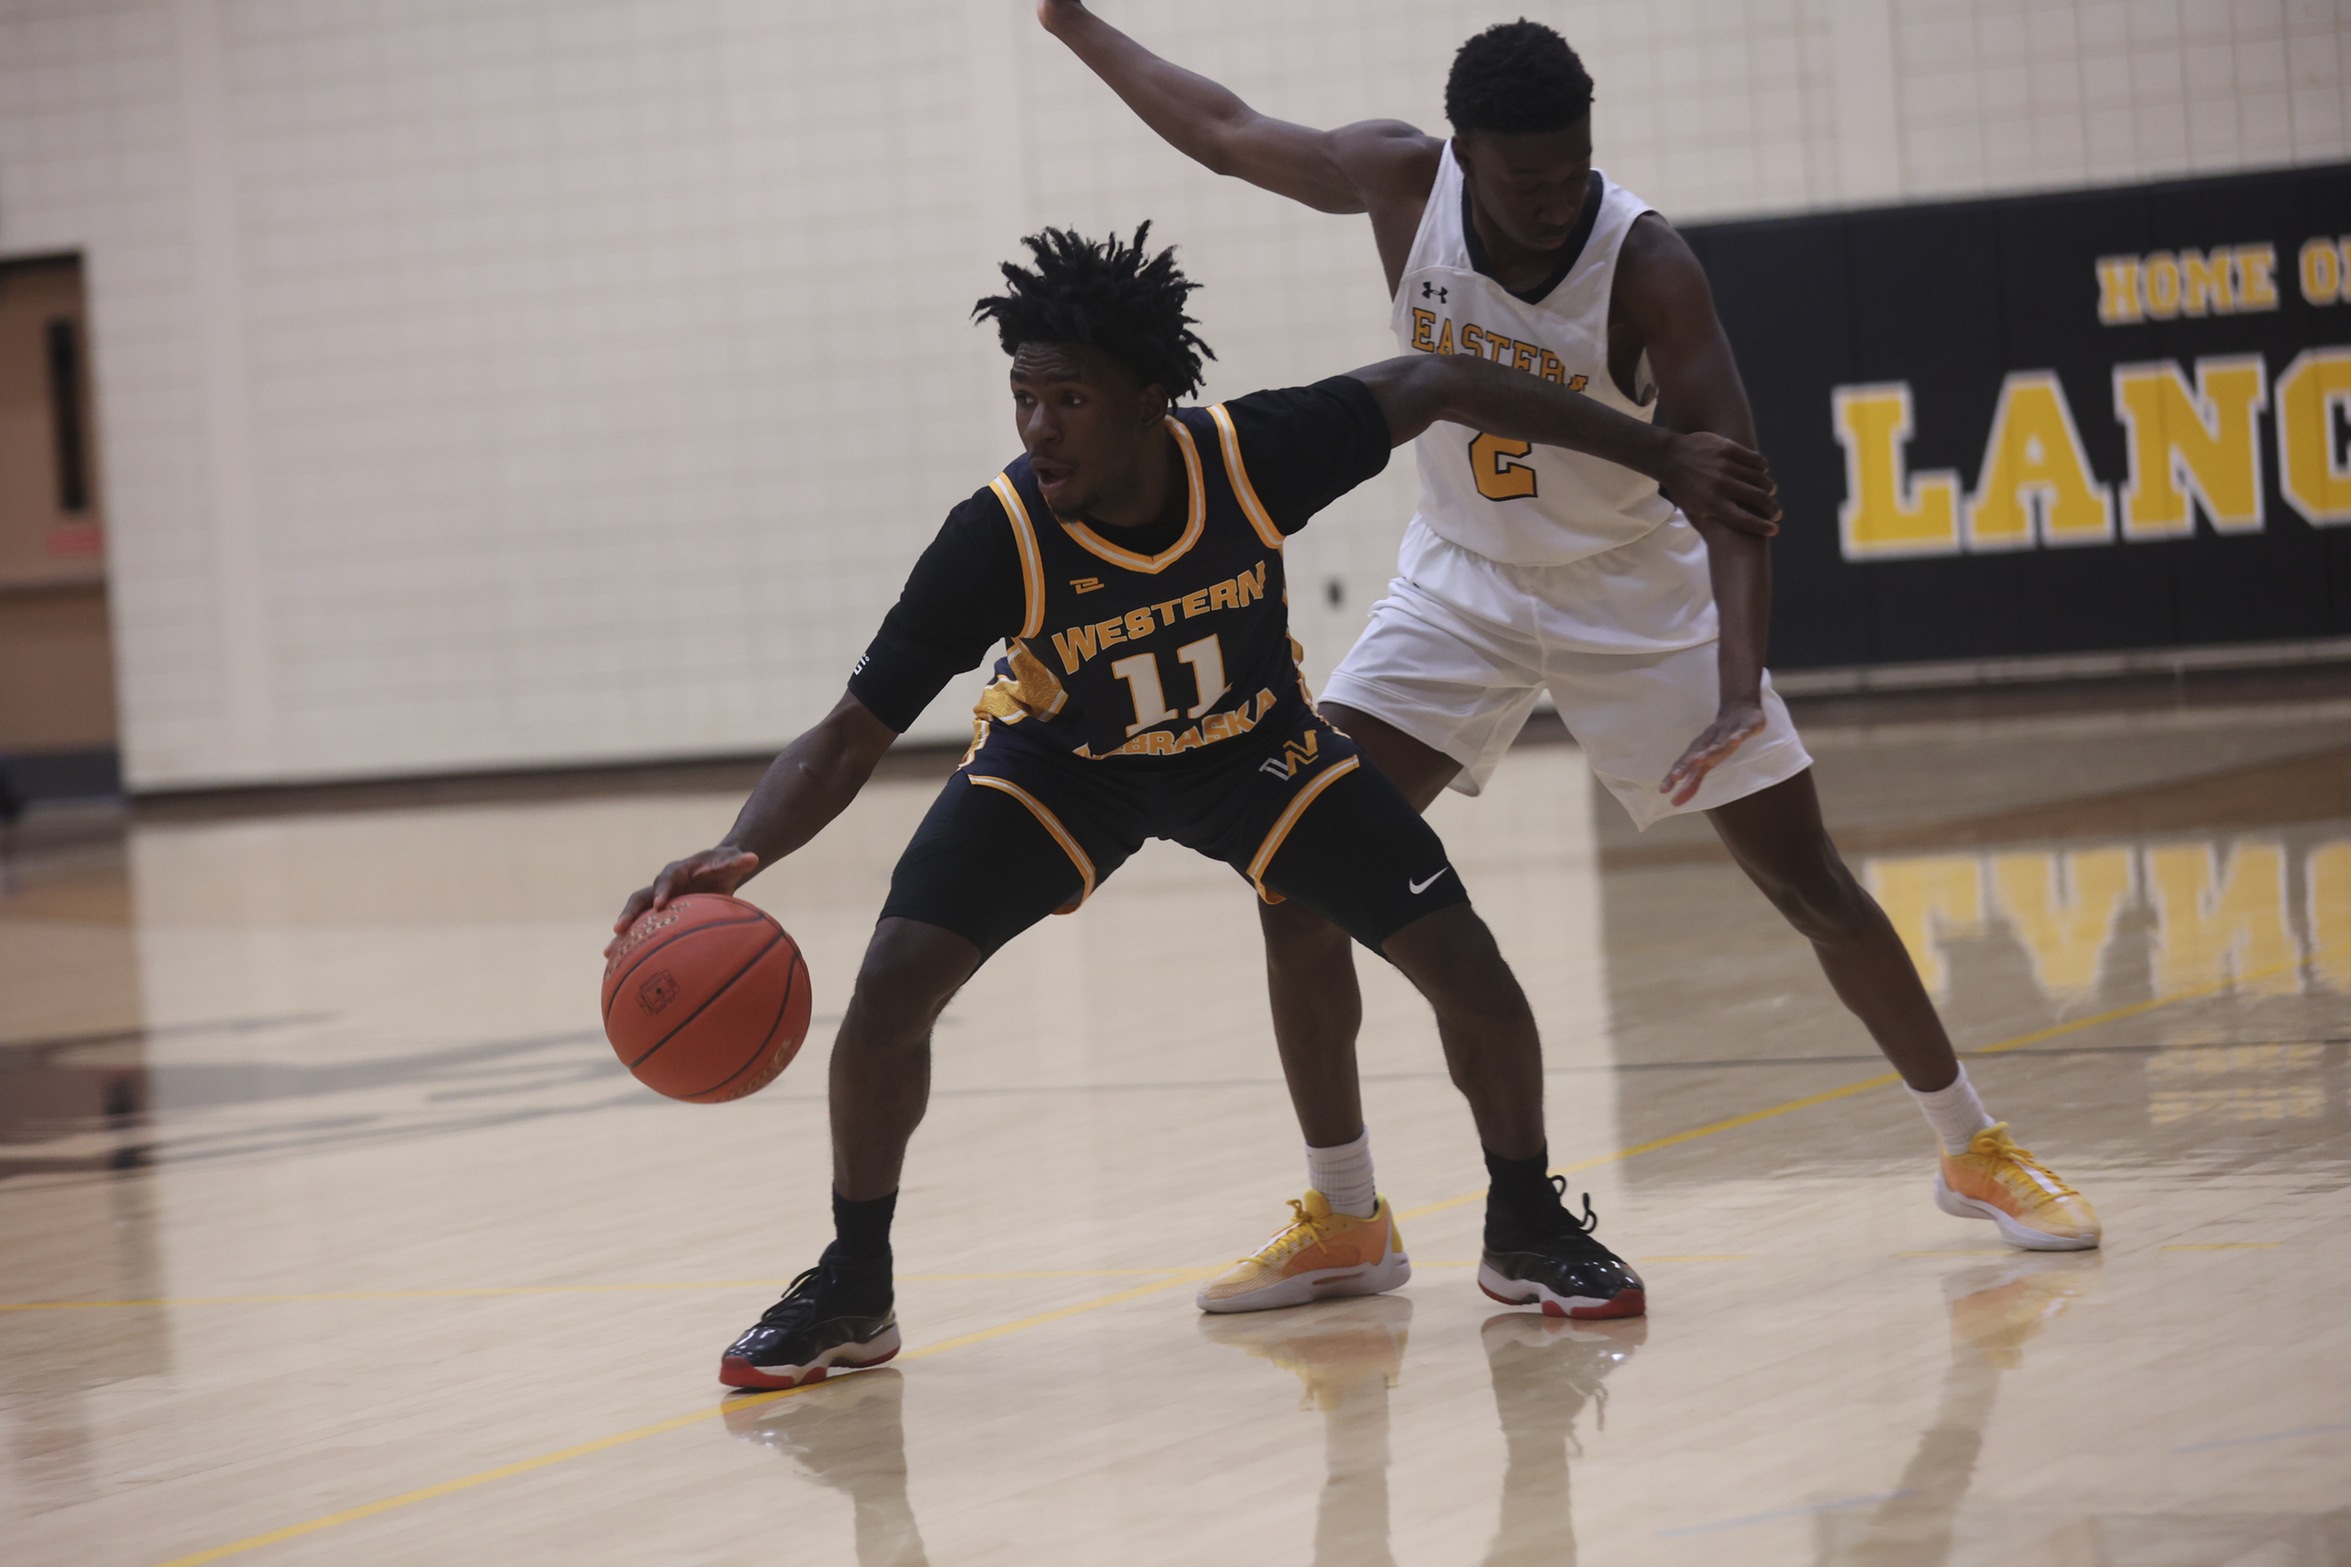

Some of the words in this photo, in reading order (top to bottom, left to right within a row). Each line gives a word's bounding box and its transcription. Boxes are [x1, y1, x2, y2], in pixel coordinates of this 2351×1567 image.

[2097, 242, 2278, 325] HOME
[1468, 432, 1538, 502] 2
[1051, 560, 1266, 675] WESTERN
[1072, 687, 1278, 760] BRASKA
[1111, 633, 1232, 738] 11
